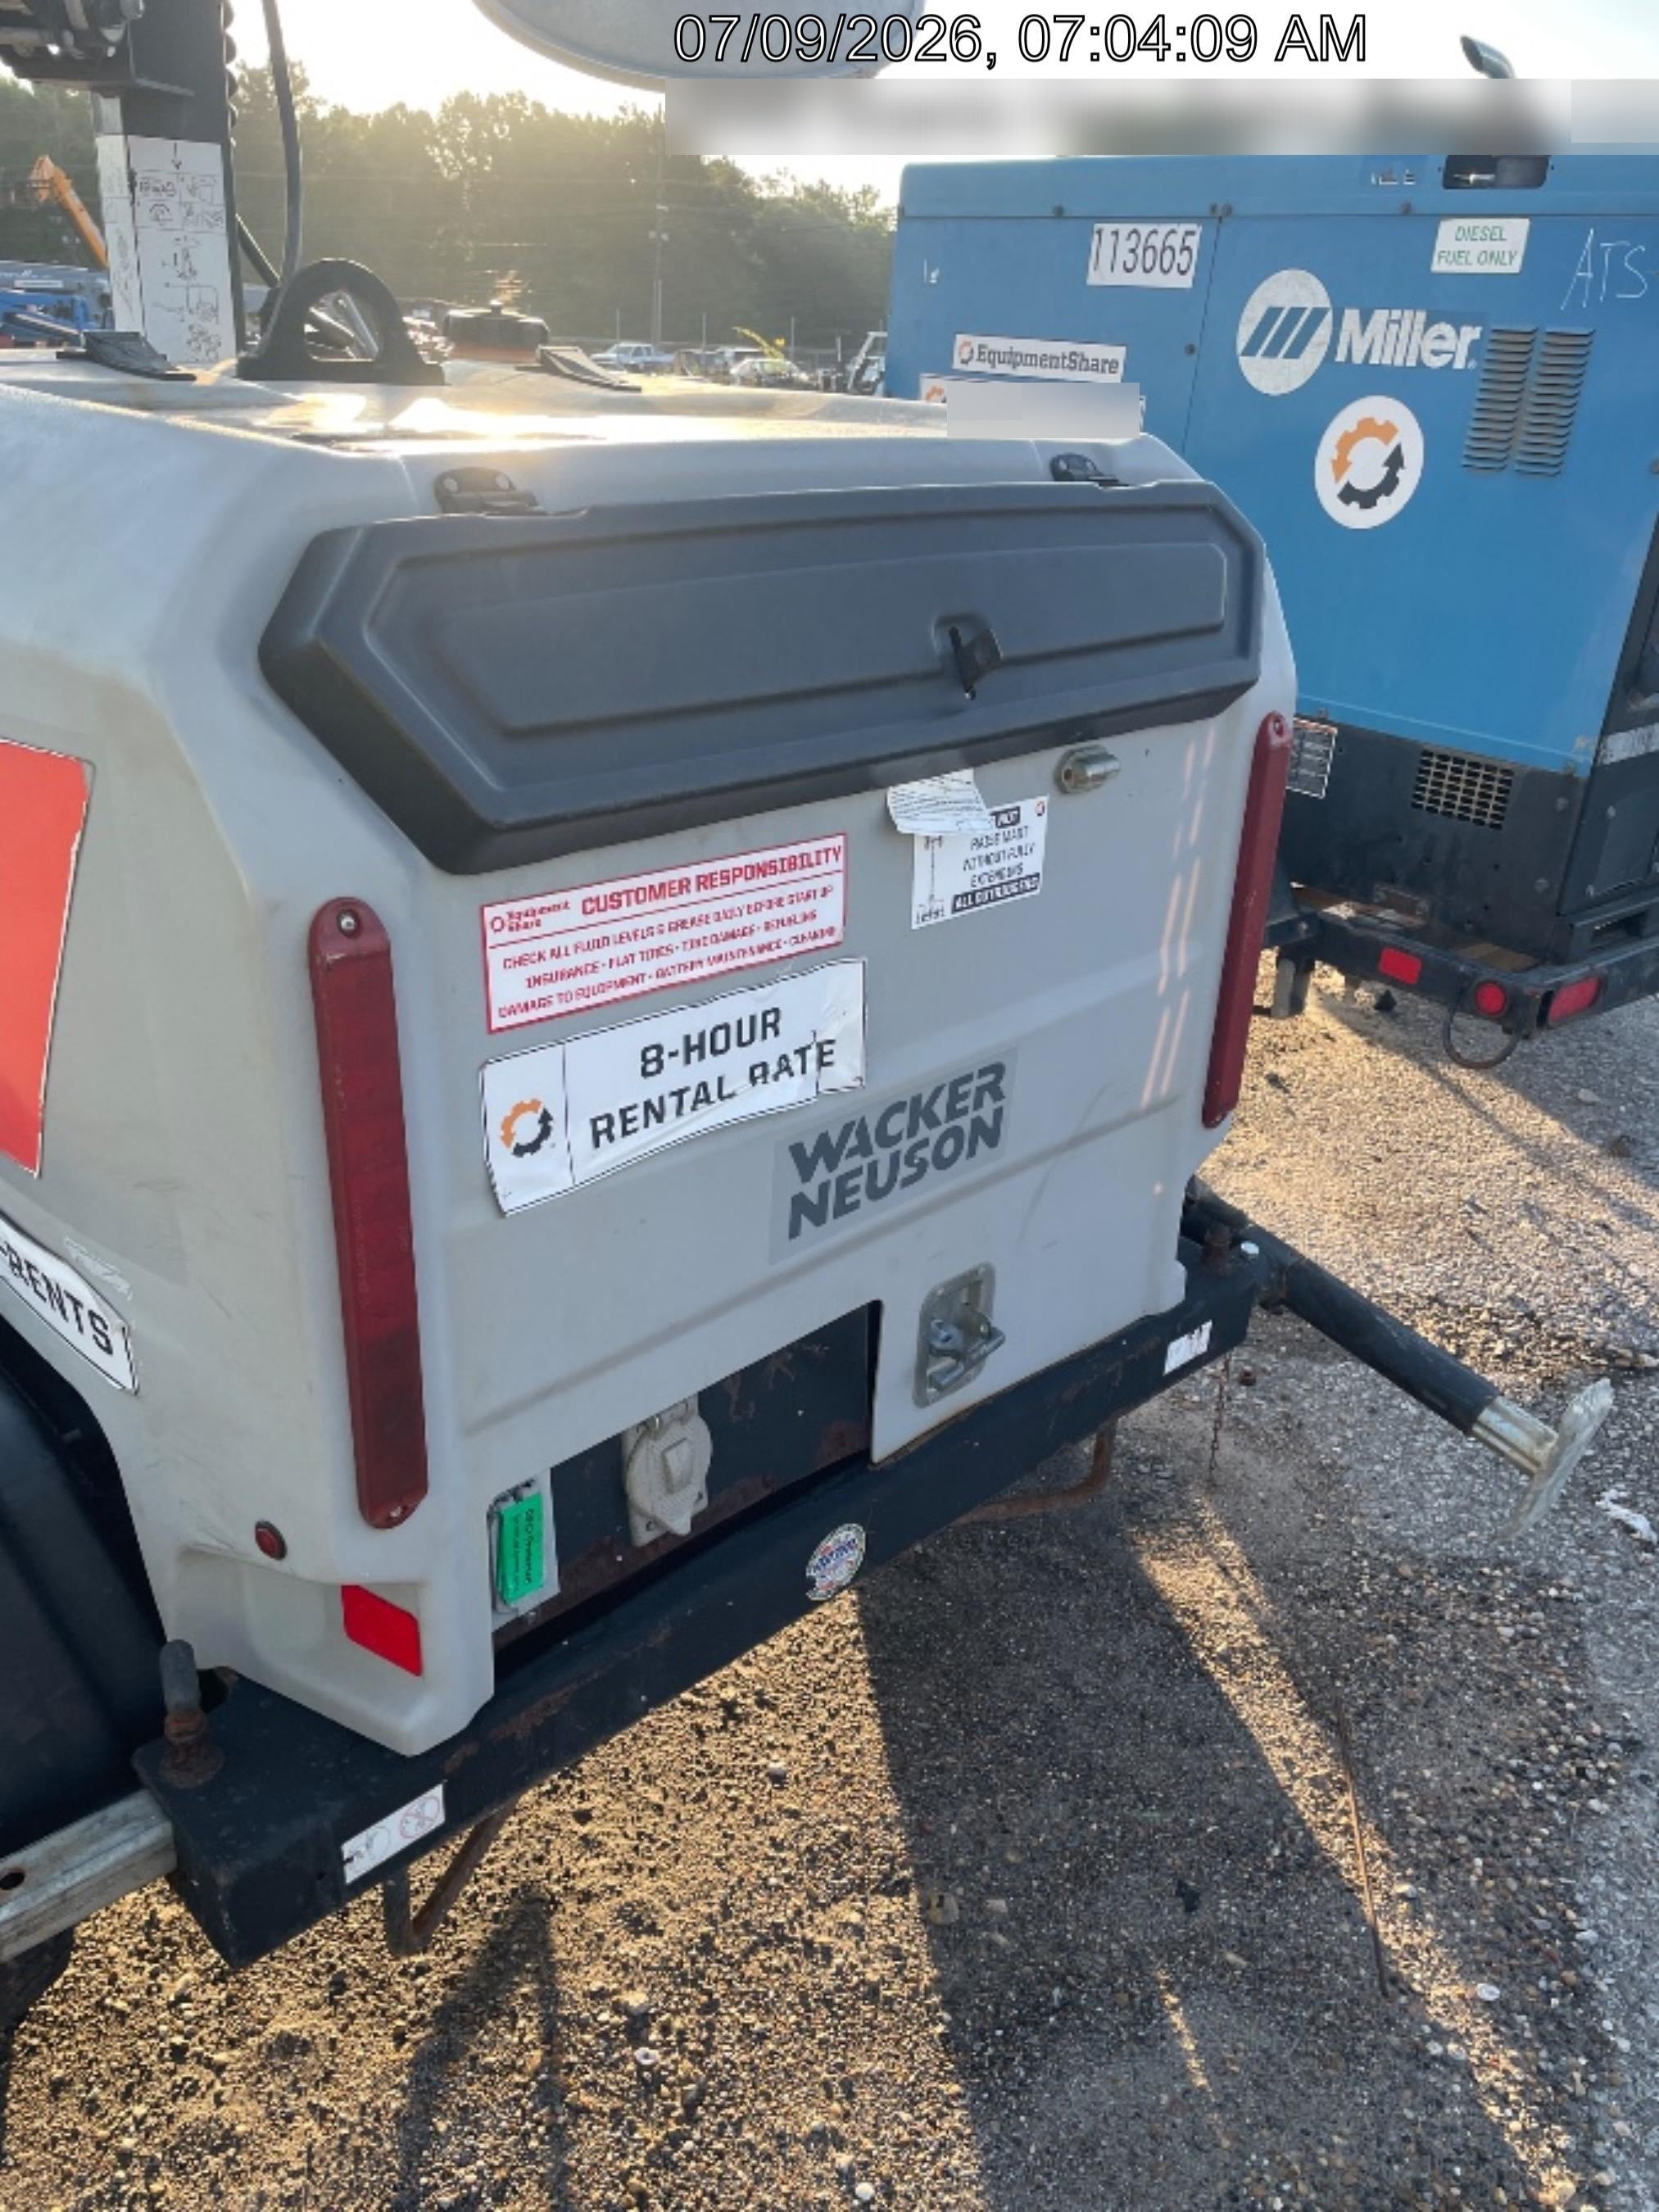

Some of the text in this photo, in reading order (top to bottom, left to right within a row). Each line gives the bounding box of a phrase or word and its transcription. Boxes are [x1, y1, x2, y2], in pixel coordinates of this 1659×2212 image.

[1093, 228, 1196, 276] 113665
[1437, 250, 1517, 265] FUEL ONLY
[1455, 225, 1507, 242] DIESEL
[1560, 228, 1648, 310] ATS
[976, 343, 1120, 374] EquipmentShare
[1335, 308, 1481, 369] Miller
[581, 845, 842, 915] CUSTOMER RESPONSIBILITY
[503, 950, 546, 969] CHECK
[550, 944, 570, 959] ALL
[574, 936, 610, 954] FLUID
[614, 925, 654, 944] LEVELS
[525, 961, 600, 989] INSURANCE
[609, 954, 635, 969] FLAT
[499, 995, 553, 1018] DAMAGE
[557, 990, 573, 1003] TO
[575, 972, 645, 1000] EQUIPMENT
[641, 1006, 782, 1079] 8-HOUR
[590, 1038, 837, 1149] RENTAL RATE
[788, 1062, 1007, 1184] WACKER
[787, 1107, 1004, 1240] NEUSON
